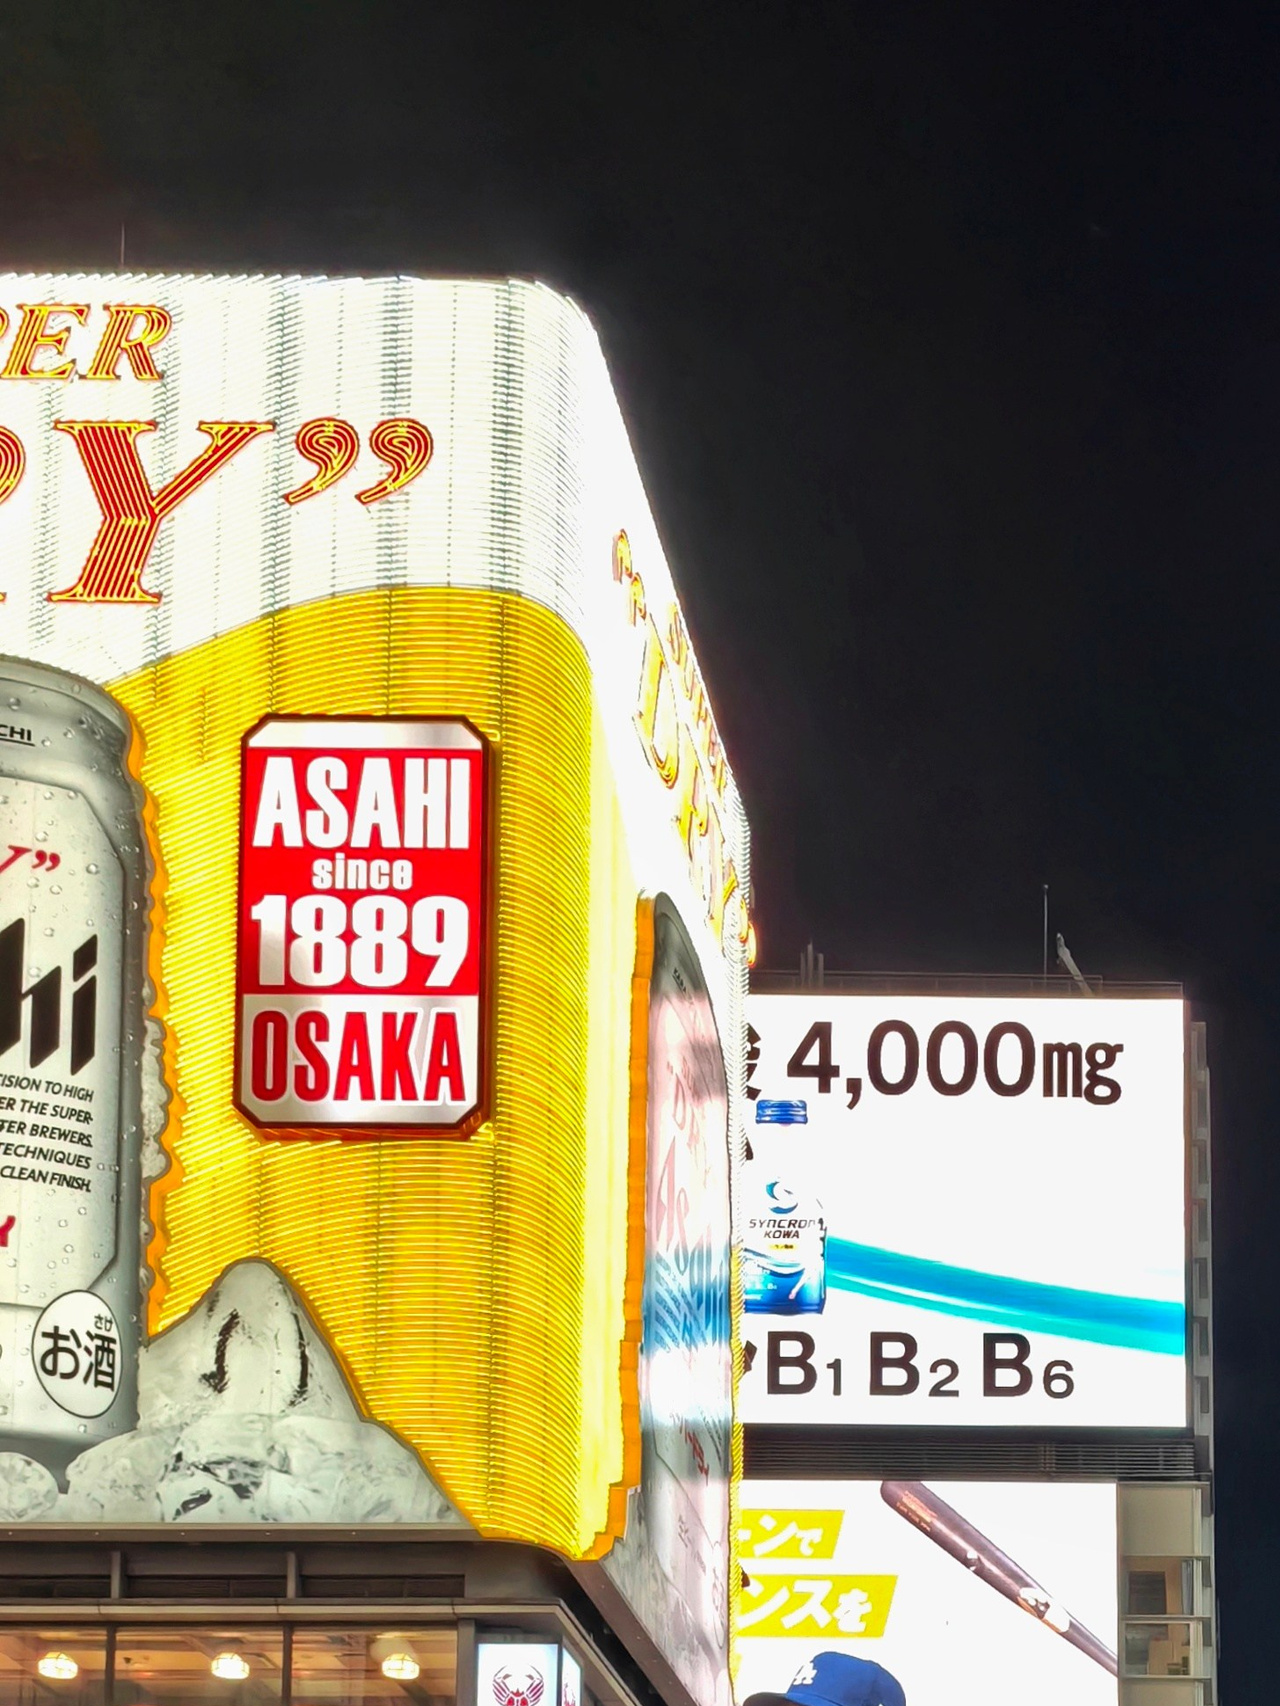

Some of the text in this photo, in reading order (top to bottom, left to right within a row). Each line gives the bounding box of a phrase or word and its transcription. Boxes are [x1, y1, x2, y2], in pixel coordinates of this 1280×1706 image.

[0, 303, 171, 380] ER
[0, 417, 434, 603] Y”
[252, 757, 470, 849] ASAHI
[312, 856, 413, 890] since
[251, 896, 470, 988] 1889
[44, 1080, 62, 1096] TO
[64, 1083, 95, 1103] HIGH
[250, 1009, 468, 1103] OSAKA
[786, 1018, 1125, 1111] 4,000mg
[21, 1098, 48, 1116] THE
[51, 1104, 94, 1125] SUPER-
[1, 1164, 49, 1186] CLEAN
[763, 1229, 801, 1240] KOWA
[40, 1323, 118, 1392] お酒
